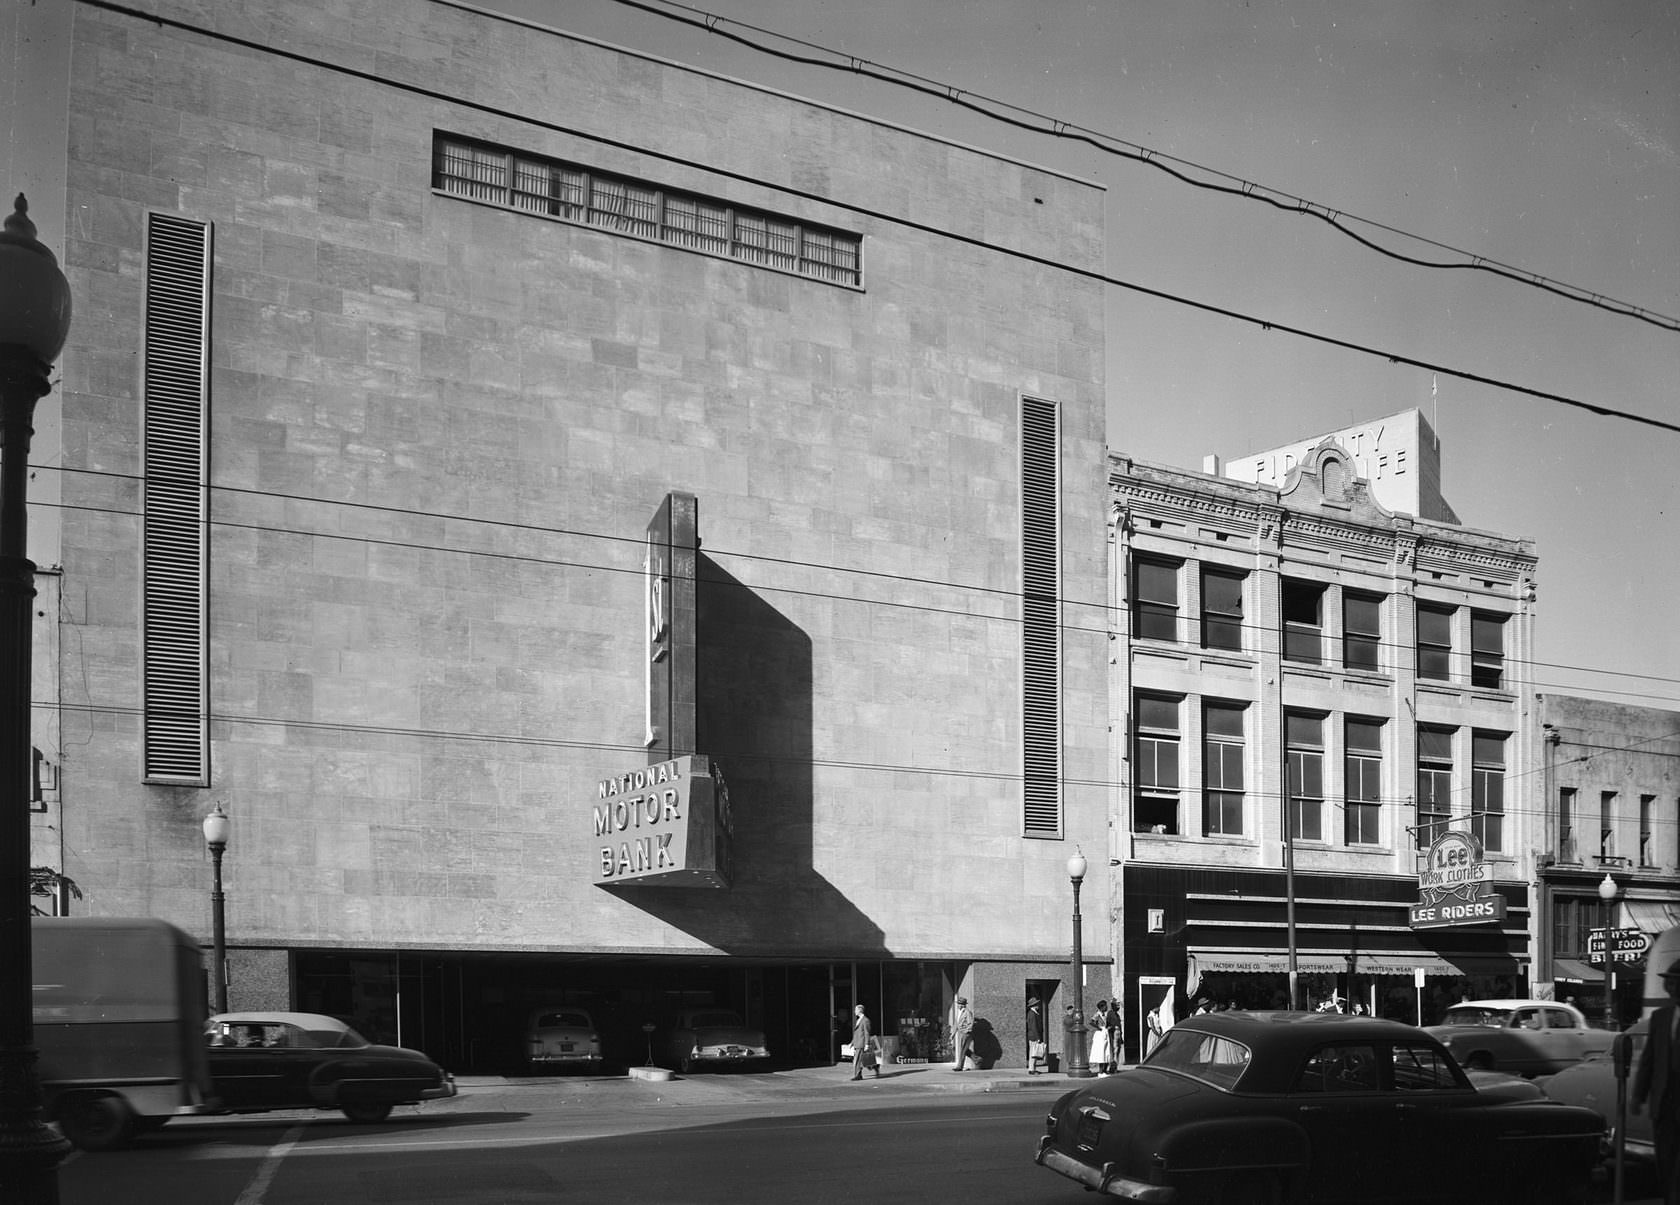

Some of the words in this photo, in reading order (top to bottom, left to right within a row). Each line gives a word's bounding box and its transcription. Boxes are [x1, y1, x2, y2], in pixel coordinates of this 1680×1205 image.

[600, 761, 681, 799] NATIONAL
[593, 789, 681, 837] MOTOR
[600, 833, 675, 878] BANK
[1437, 847, 1468, 869] Lee
[1420, 870, 1444, 886] WORK
[1446, 865, 1484, 884] CLOTHES
[1411, 908, 1436, 923] LEE
[1441, 902, 1495, 920] RIDERS
[1618, 939, 1645, 949] FOOD
